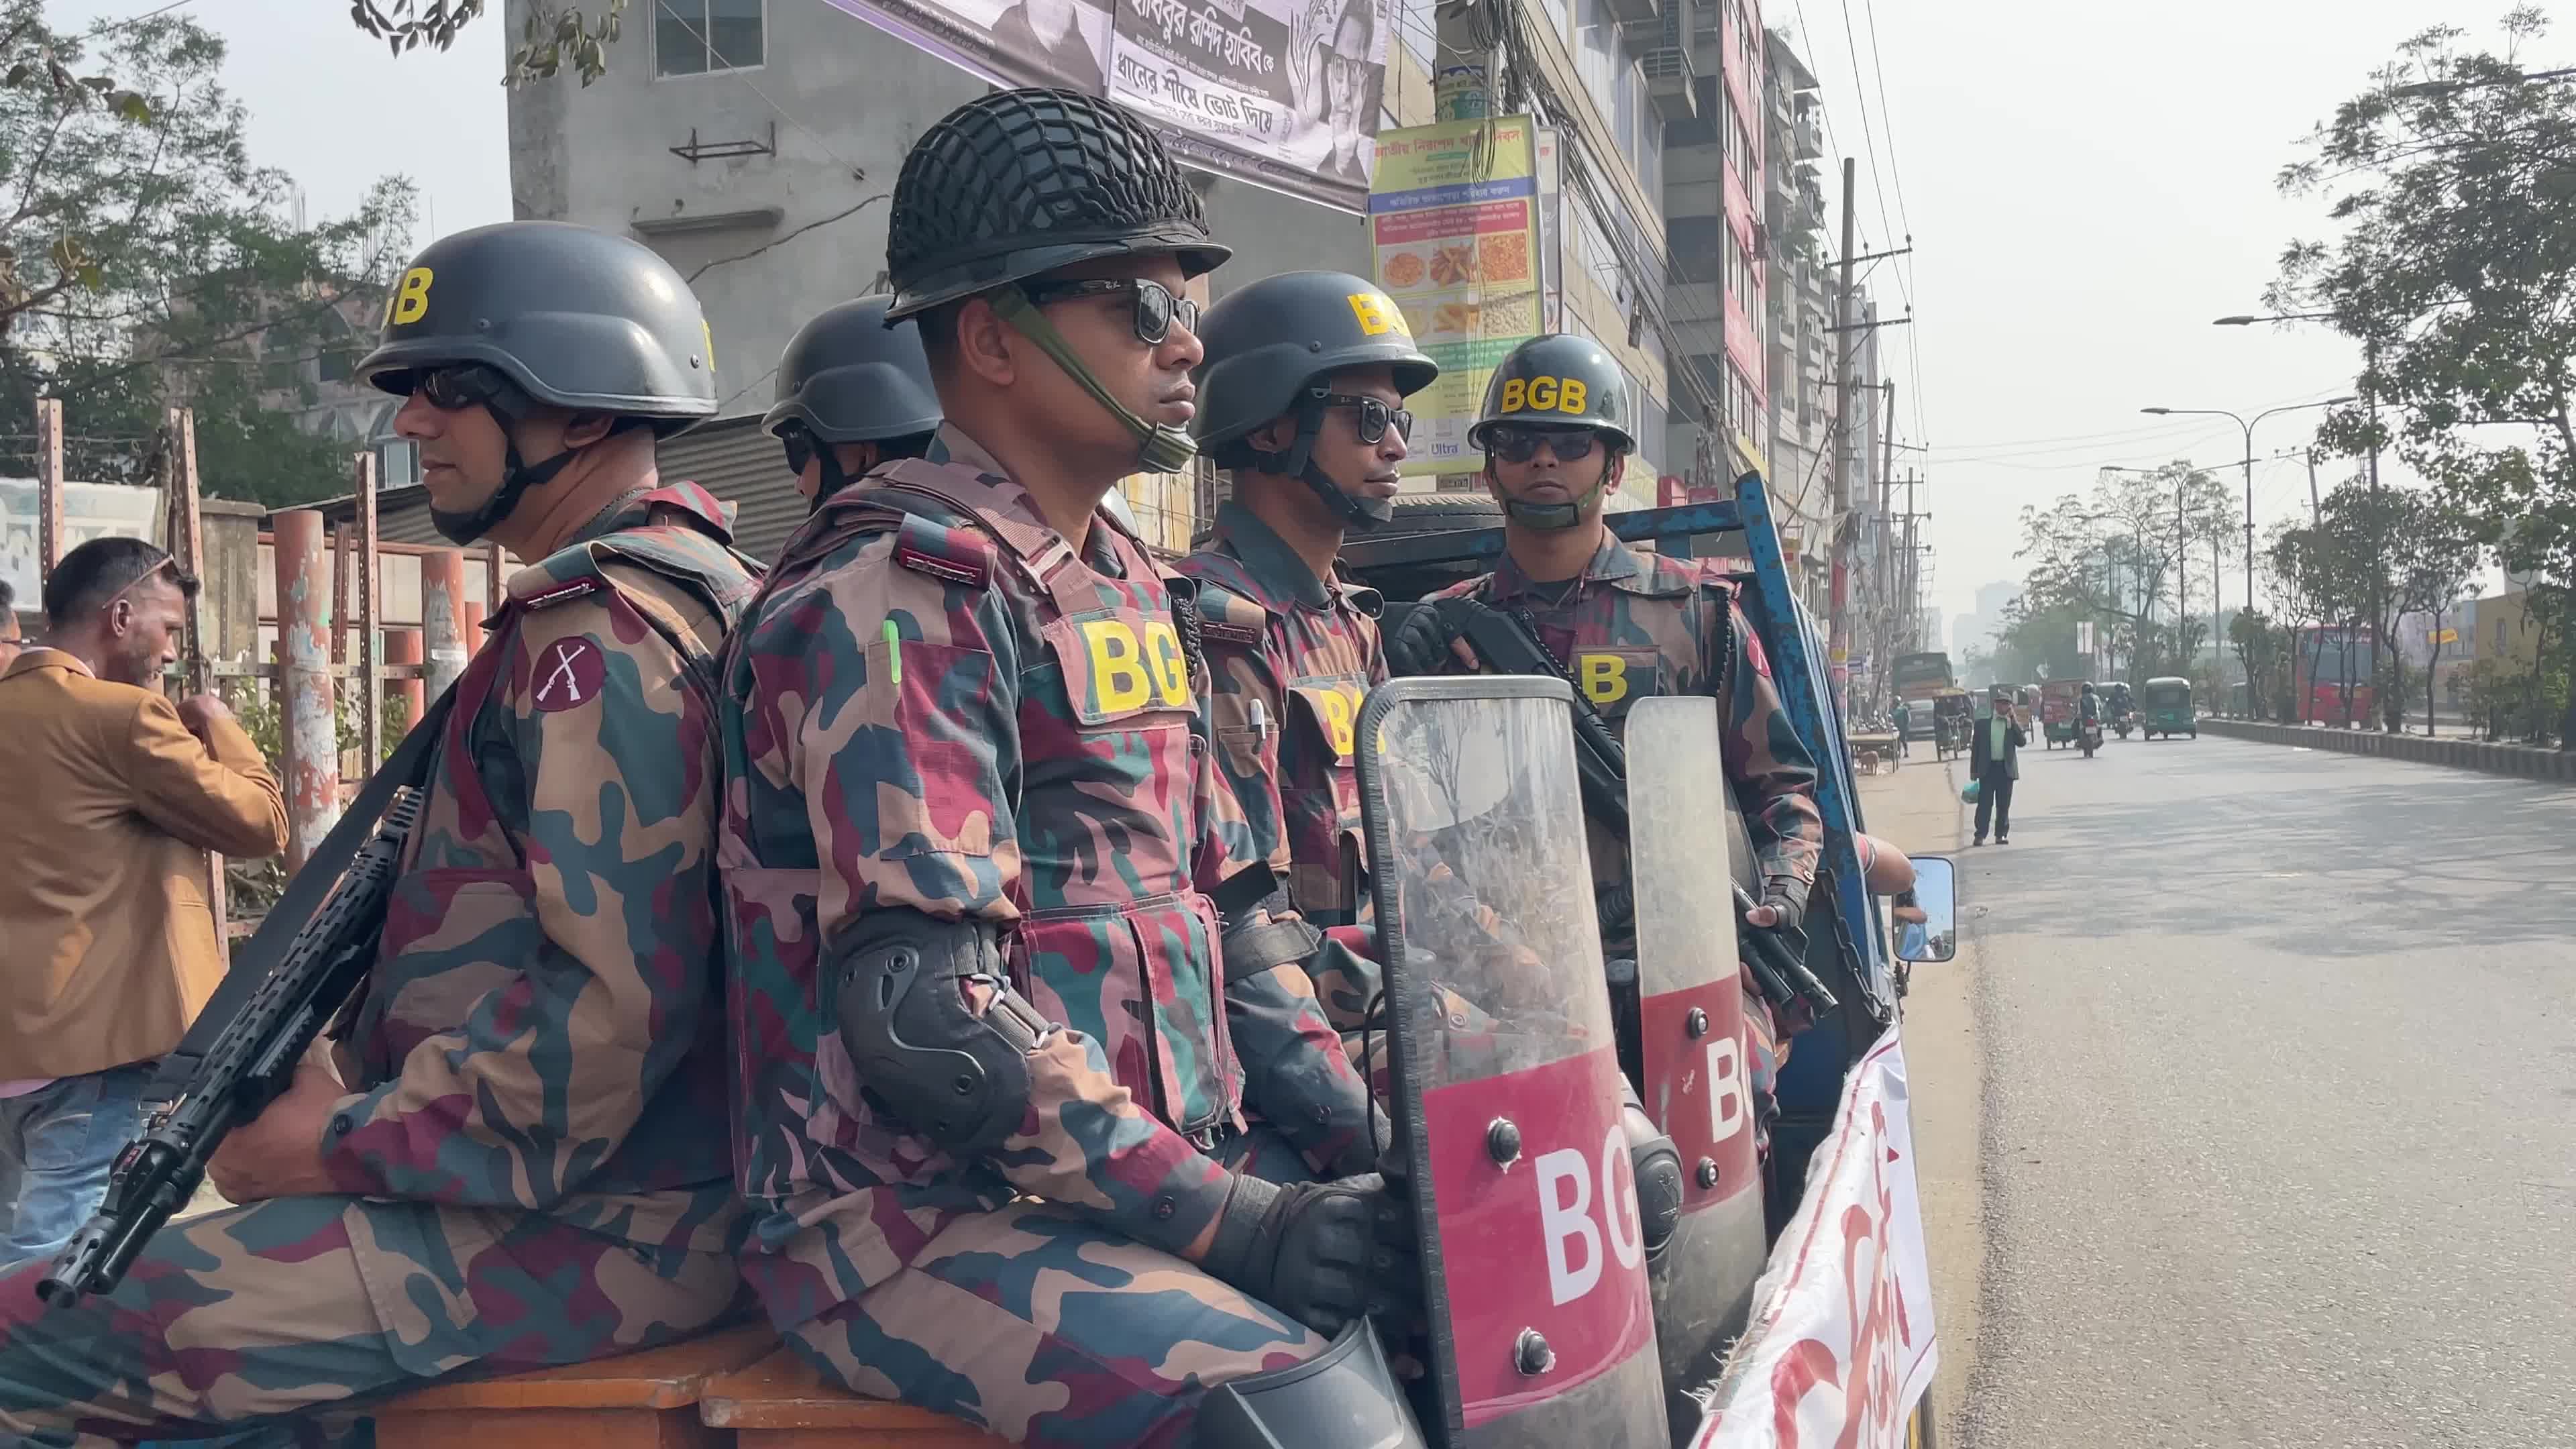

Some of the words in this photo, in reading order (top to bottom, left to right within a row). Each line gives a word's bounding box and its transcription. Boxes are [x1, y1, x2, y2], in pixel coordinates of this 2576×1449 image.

[1189, 6, 1225, 57] রশিদ
[1224, 27, 1263, 74] হাবিব
[1118, 52, 1159, 95] ধানের
[1161, 69, 1200, 109] শীষে
[1204, 93, 1240, 120] ভোট
[1240, 95, 1273, 136] দিয়ে
[1501, 376, 1588, 415] BGB
[1431, 443, 1459, 455] Ultra
[1570, 655, 1628, 706] B
